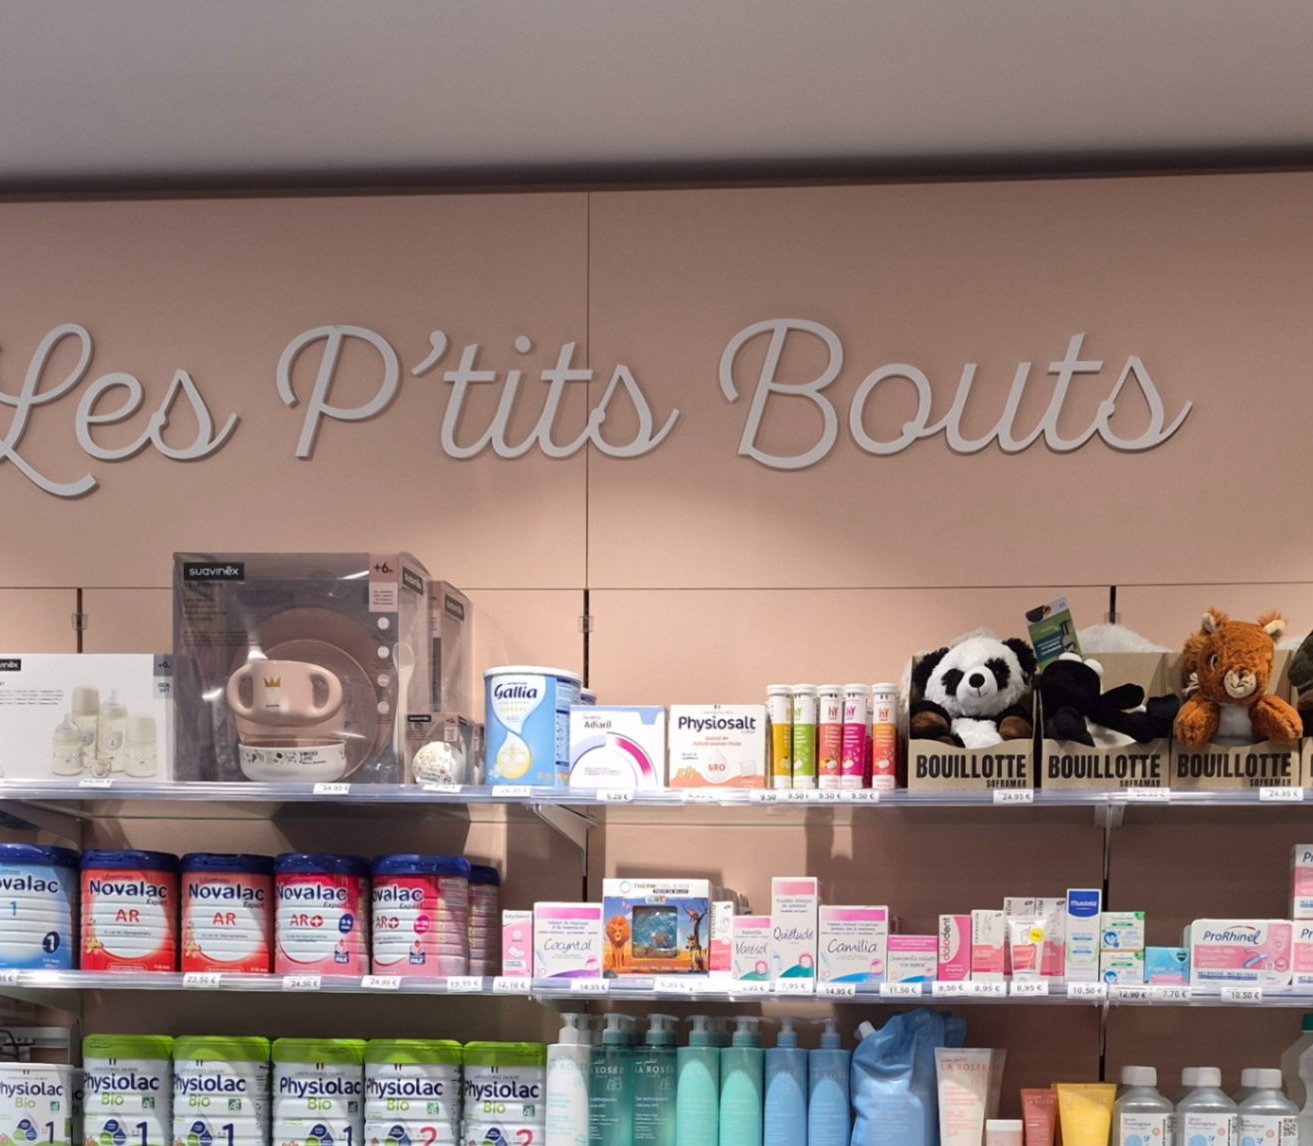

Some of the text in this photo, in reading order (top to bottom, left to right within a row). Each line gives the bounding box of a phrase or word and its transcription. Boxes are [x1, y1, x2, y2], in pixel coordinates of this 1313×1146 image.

[718, 317, 1194, 470] Bouts
[494, 683, 538, 700] Gallia
[677, 715, 757, 732] Physiosalt
[916, 754, 1026, 780] BOUILLOTTE
[1048, 754, 1161, 780] BOUILLOTTE
[1177, 752, 1291, 779] BOUILLOTTE
[89, 879, 168, 899] Novalac
[189, 883, 264, 901] Novalac
[115, 908, 139, 923] AR
[213, 911, 236, 926] AR
[827, 937, 878, 955] Camilia
[1202, 930, 1262, 945] ProRhinel
[279, 1077, 361, 1097] Physiolac
[366, 1078, 444, 1096] Physiolac
[464, 1080, 539, 1099] Physiolac
